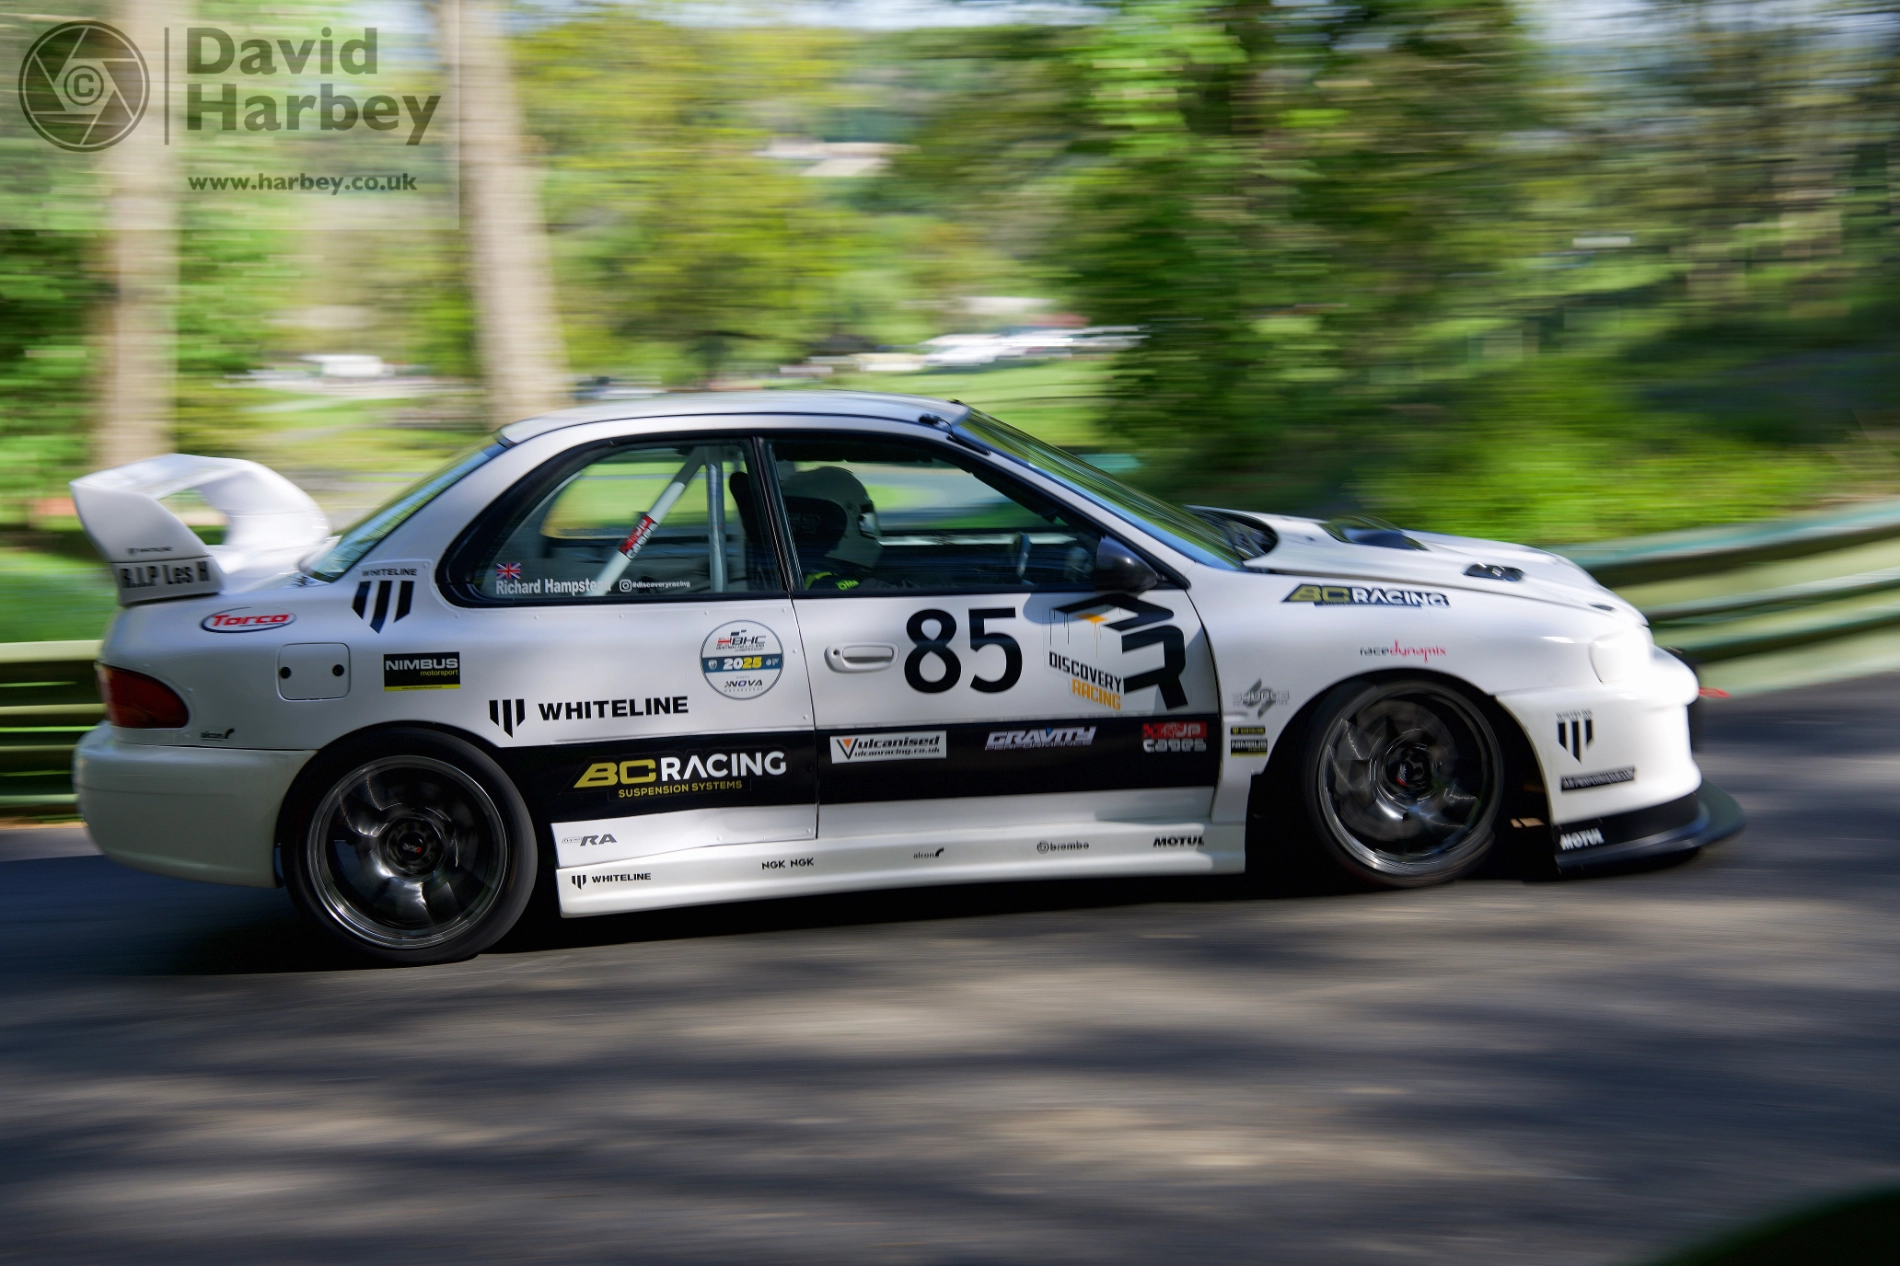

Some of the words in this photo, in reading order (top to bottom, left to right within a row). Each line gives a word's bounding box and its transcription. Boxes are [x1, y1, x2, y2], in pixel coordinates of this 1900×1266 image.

[496, 579, 541, 595] Richard
[1289, 585, 1350, 602] BC
[1352, 587, 1450, 606] RACING
[212, 614, 290, 627] Torco
[904, 607, 1023, 694] 85
[385, 658, 458, 671] NIMBUS
[723, 656, 762, 670] 2025
[1049, 651, 1122, 693] DISCOVERY
[1072, 678, 1121, 711] RACING
[538, 696, 689, 721] WHITELINE
[986, 726, 1097, 748] GRAVITY
[836, 735, 940, 760] Vulcanised
[573, 759, 657, 788] BC
[660, 751, 787, 781] RACING
[618, 783, 689, 798] SUSPENSION
[691, 780, 743, 793] SYSTEMS
[580, 834, 617, 847] RA
[1153, 836, 1205, 848] MOTUL
[761, 860, 786, 870] NGK
[790, 857, 815, 868] NGK
[591, 873, 652, 883] WHITELINE
